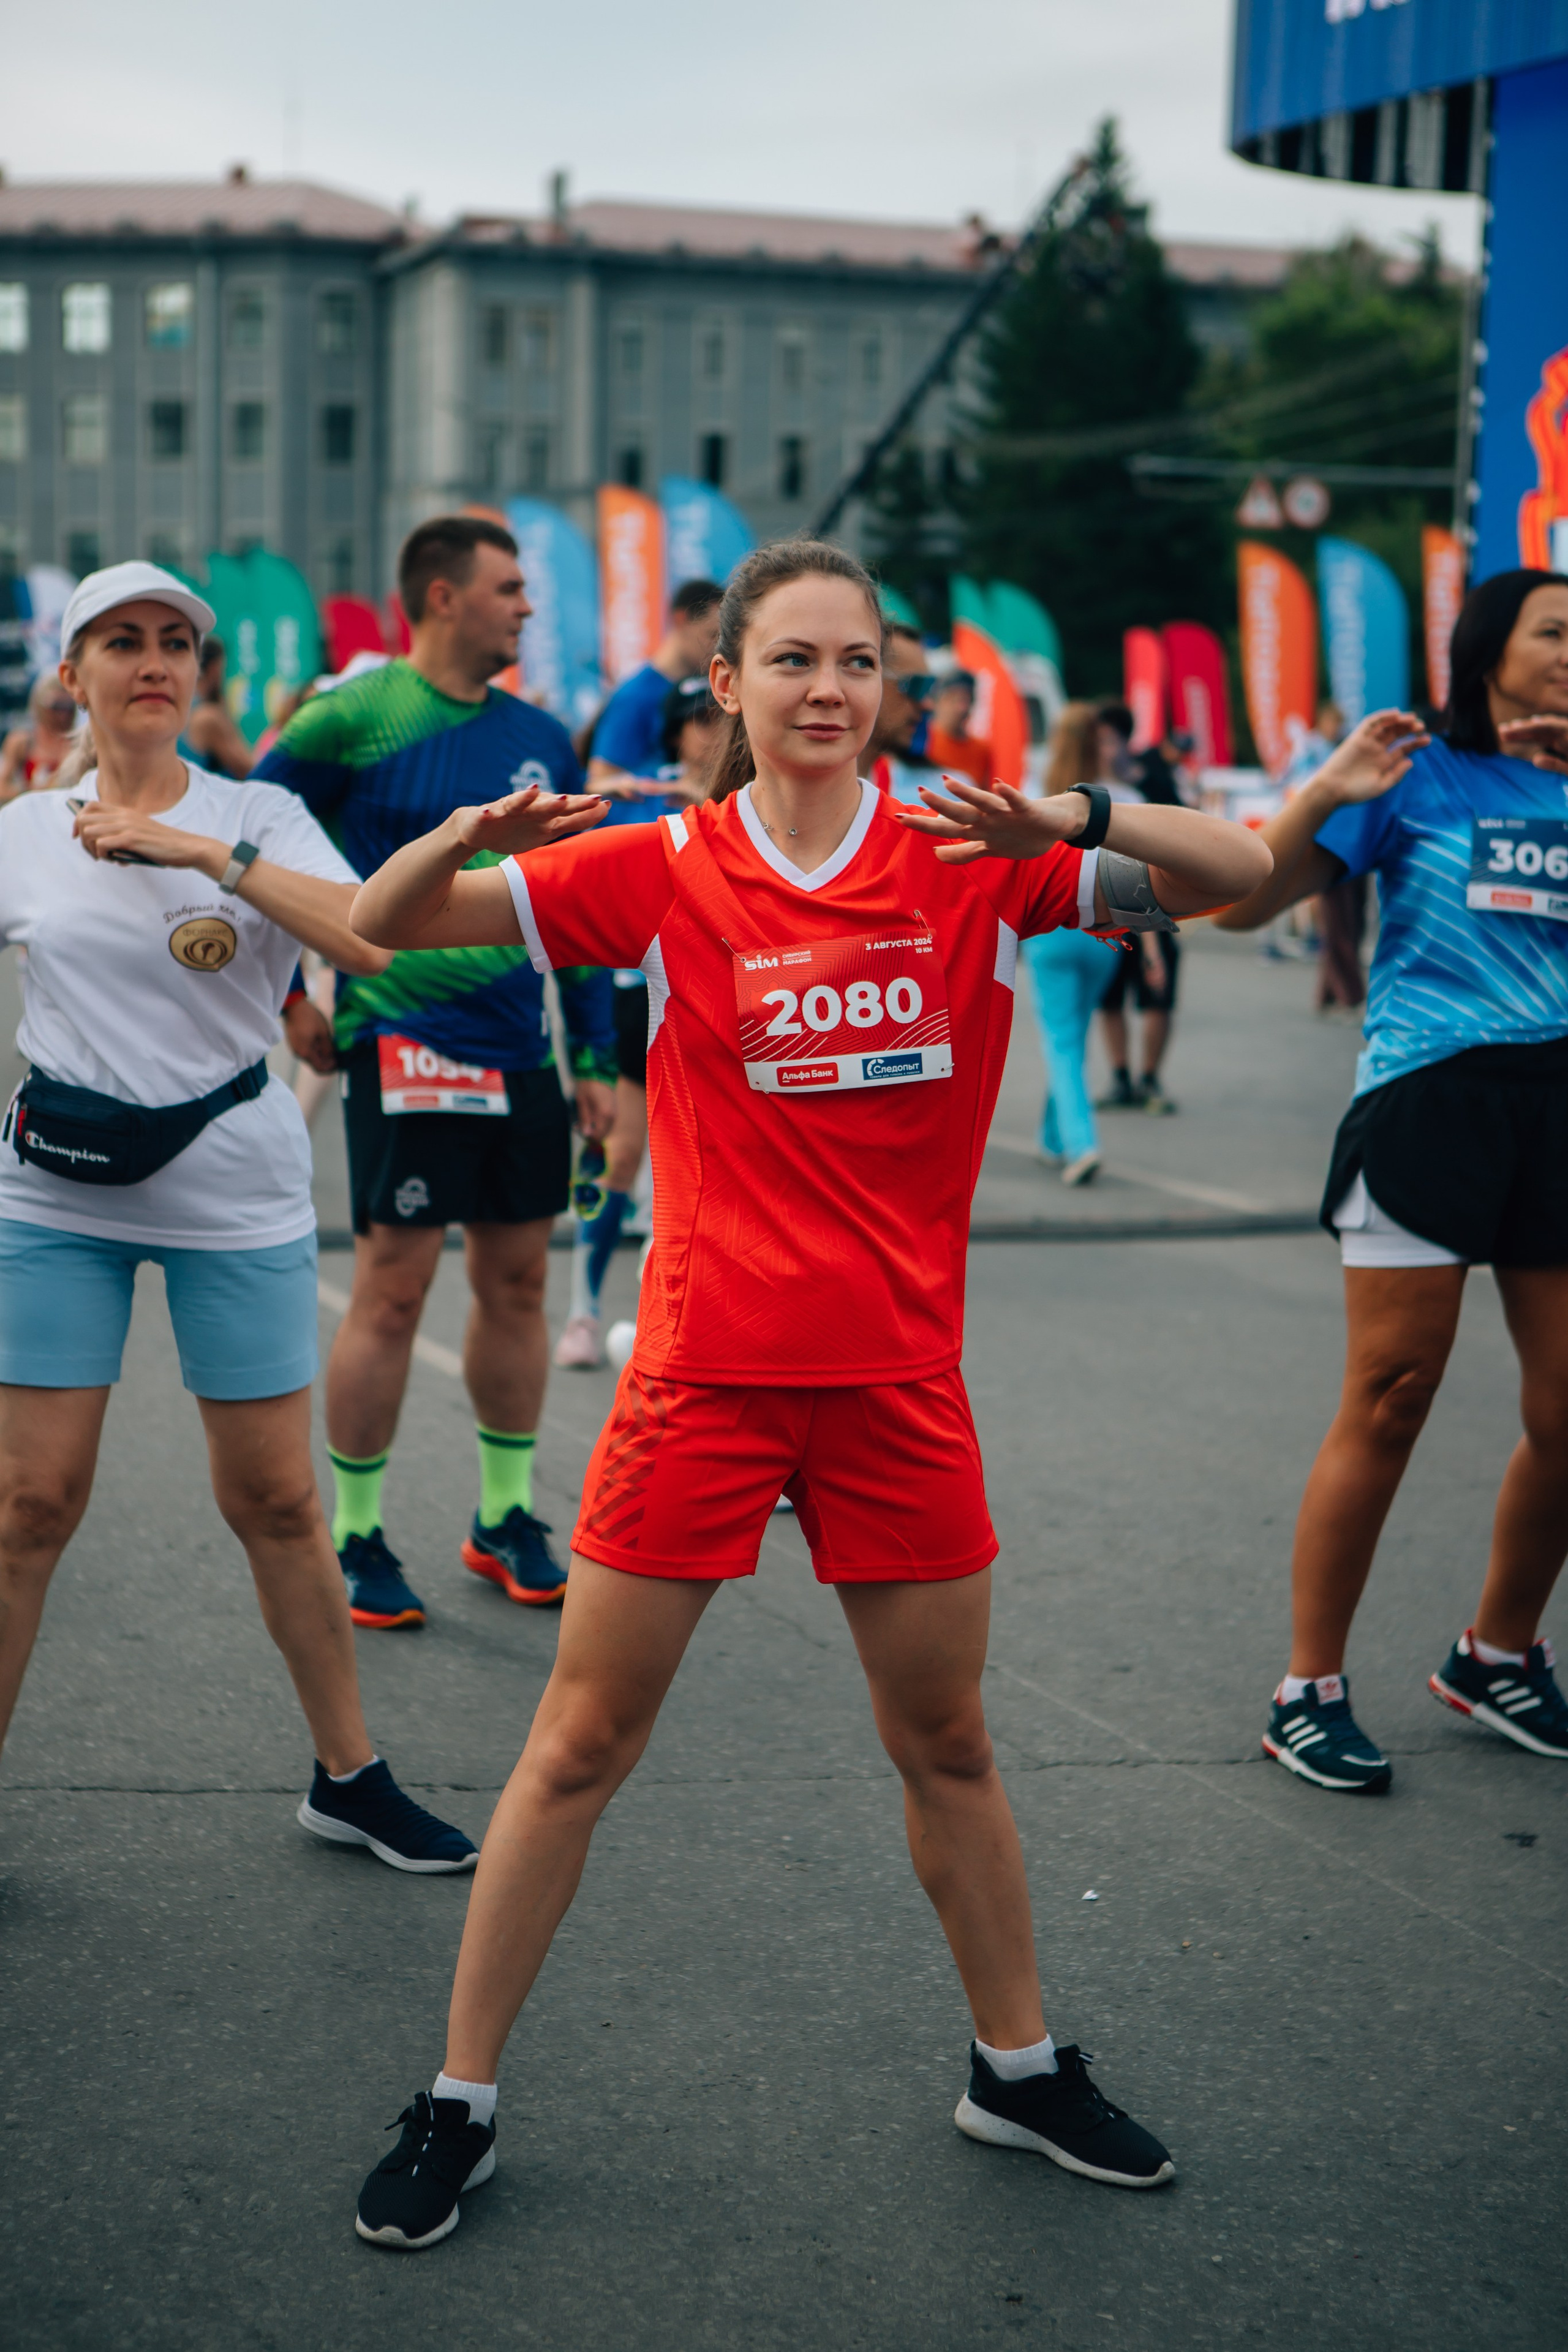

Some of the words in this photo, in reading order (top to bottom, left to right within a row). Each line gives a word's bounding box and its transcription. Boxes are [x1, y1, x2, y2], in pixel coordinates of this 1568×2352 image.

[163, 903, 214, 924] Добрый
[873, 939, 913, 949] АВГУСТА
[913, 937, 932, 946] 2024
[761, 977, 922, 1036] 2080
[782, 1071, 810, 1083] Альфа
[811, 1069, 834, 1078] Банк
[873, 1063, 919, 1074] Следопыт
[25, 1131, 110, 1164] Champion
